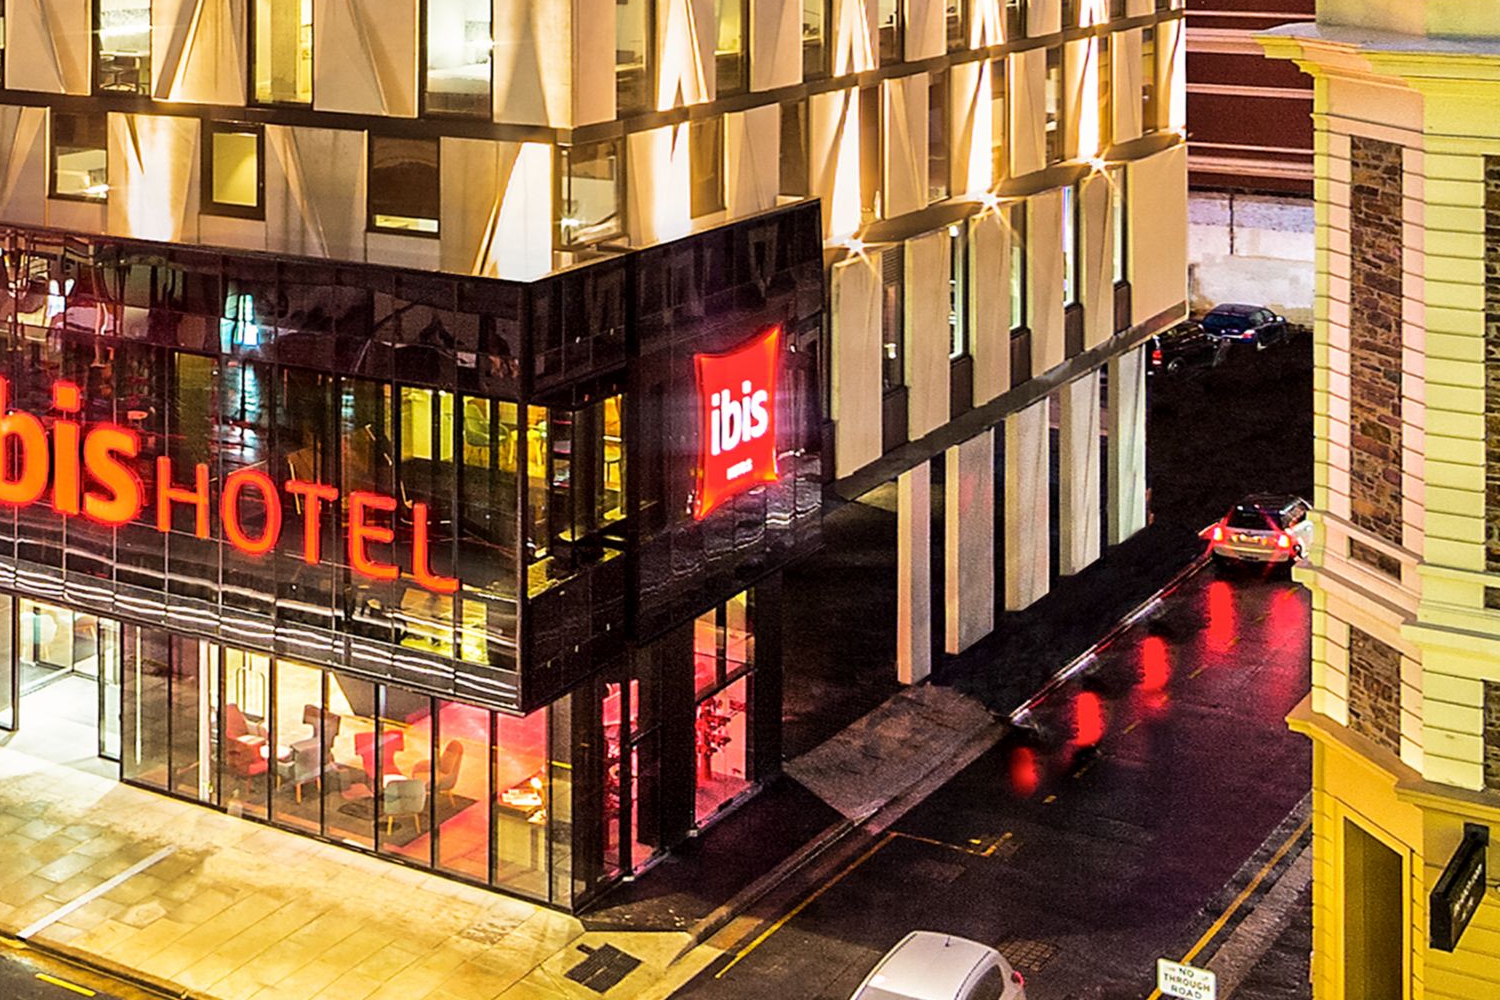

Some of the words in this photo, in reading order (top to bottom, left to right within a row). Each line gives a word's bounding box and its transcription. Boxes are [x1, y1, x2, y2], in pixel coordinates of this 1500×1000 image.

[711, 380, 769, 456] ibis
[155, 455, 460, 594] HOTEL
[1178, 967, 1195, 978] NO
[1164, 973, 1210, 992] THROUGH
[1171, 984, 1203, 1000] ROAD
